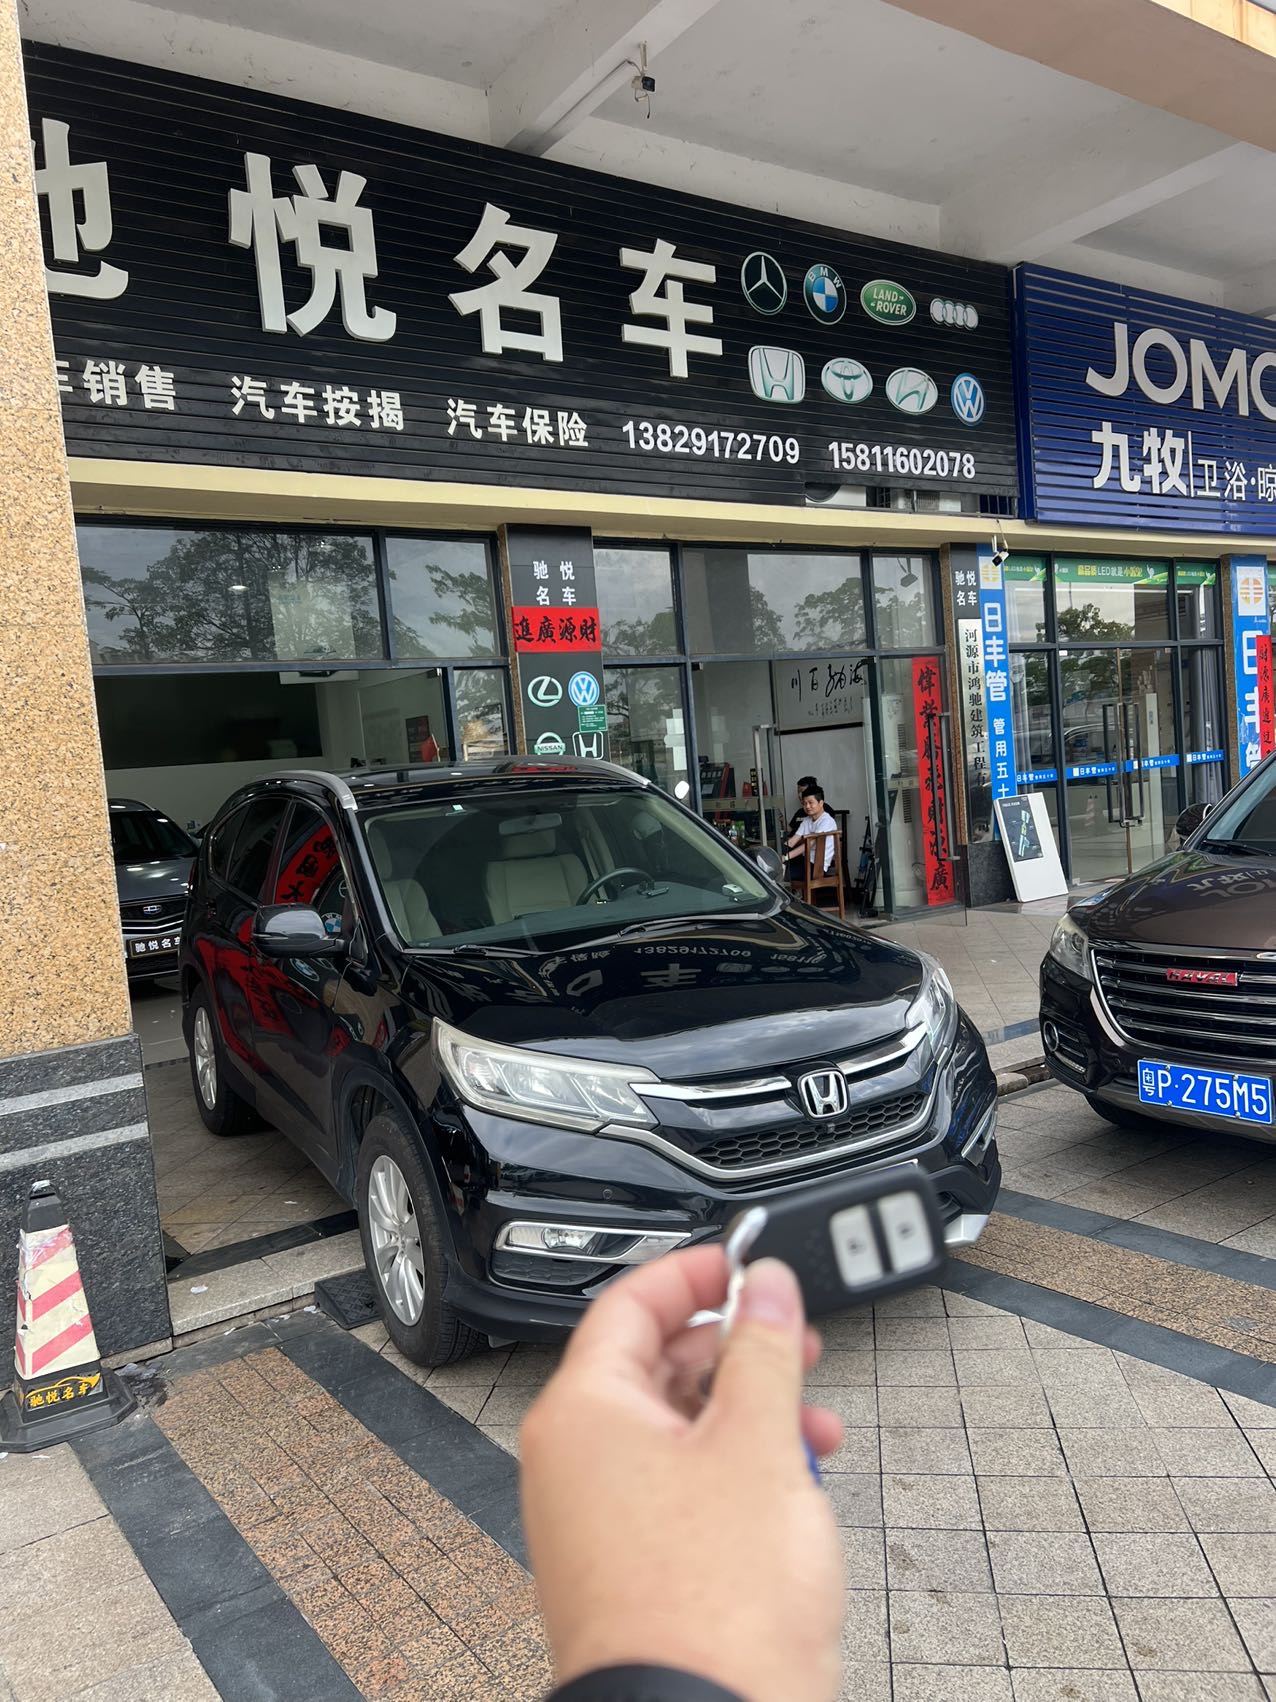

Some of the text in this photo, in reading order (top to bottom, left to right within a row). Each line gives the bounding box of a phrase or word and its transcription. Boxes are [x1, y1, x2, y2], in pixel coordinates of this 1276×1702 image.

[231, 375, 404, 432] 汽车按揭
[446, 398, 589, 448] 汽车保险
[621, 420, 800, 465] 13829172709
[828, 441, 976, 480] 15811602078
[533, 560, 575, 581] 驰悦
[955, 570, 977, 587] 驰悦
[536, 586, 577, 606] 名车
[956, 590, 978, 607] 名车
[983, 602, 1008, 702] 日丰管
[30, 1383, 89, 1406] 驰悦名车
